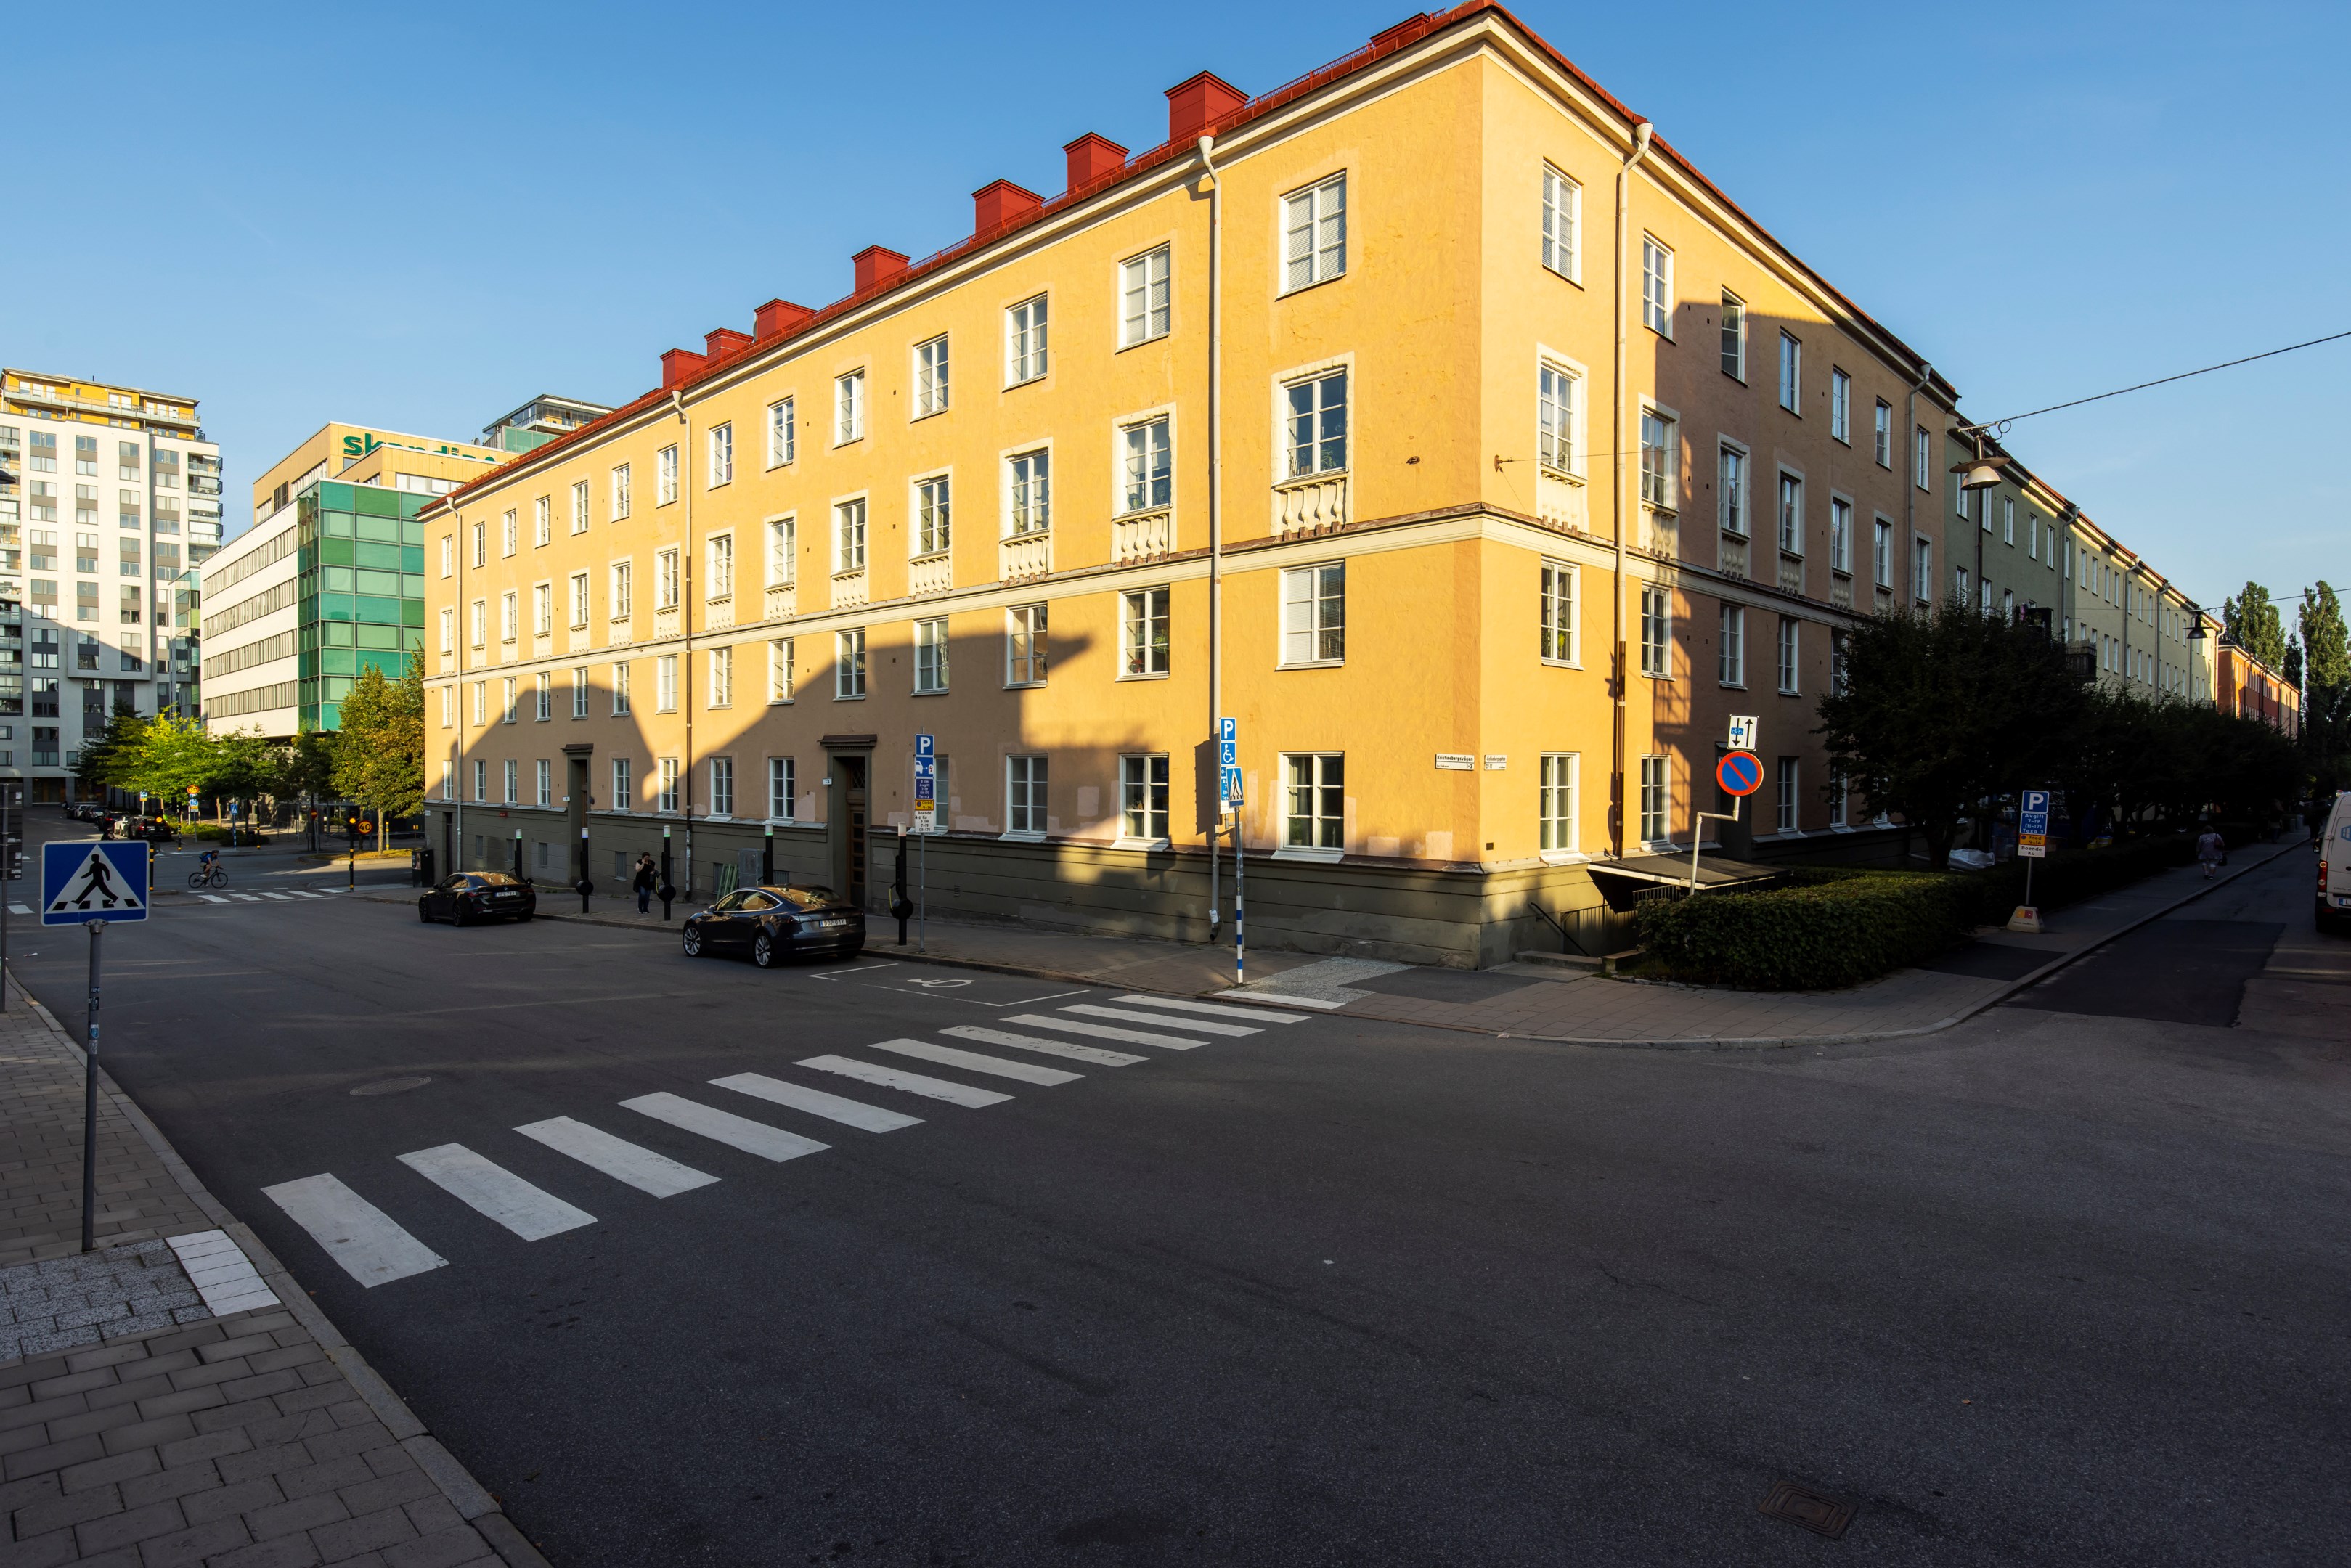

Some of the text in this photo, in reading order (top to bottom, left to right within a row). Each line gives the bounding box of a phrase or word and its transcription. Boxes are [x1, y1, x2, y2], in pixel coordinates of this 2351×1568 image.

[1224, 719, 1234, 739] P
[920, 736, 931, 754] P
[2029, 793, 2044, 810] P
